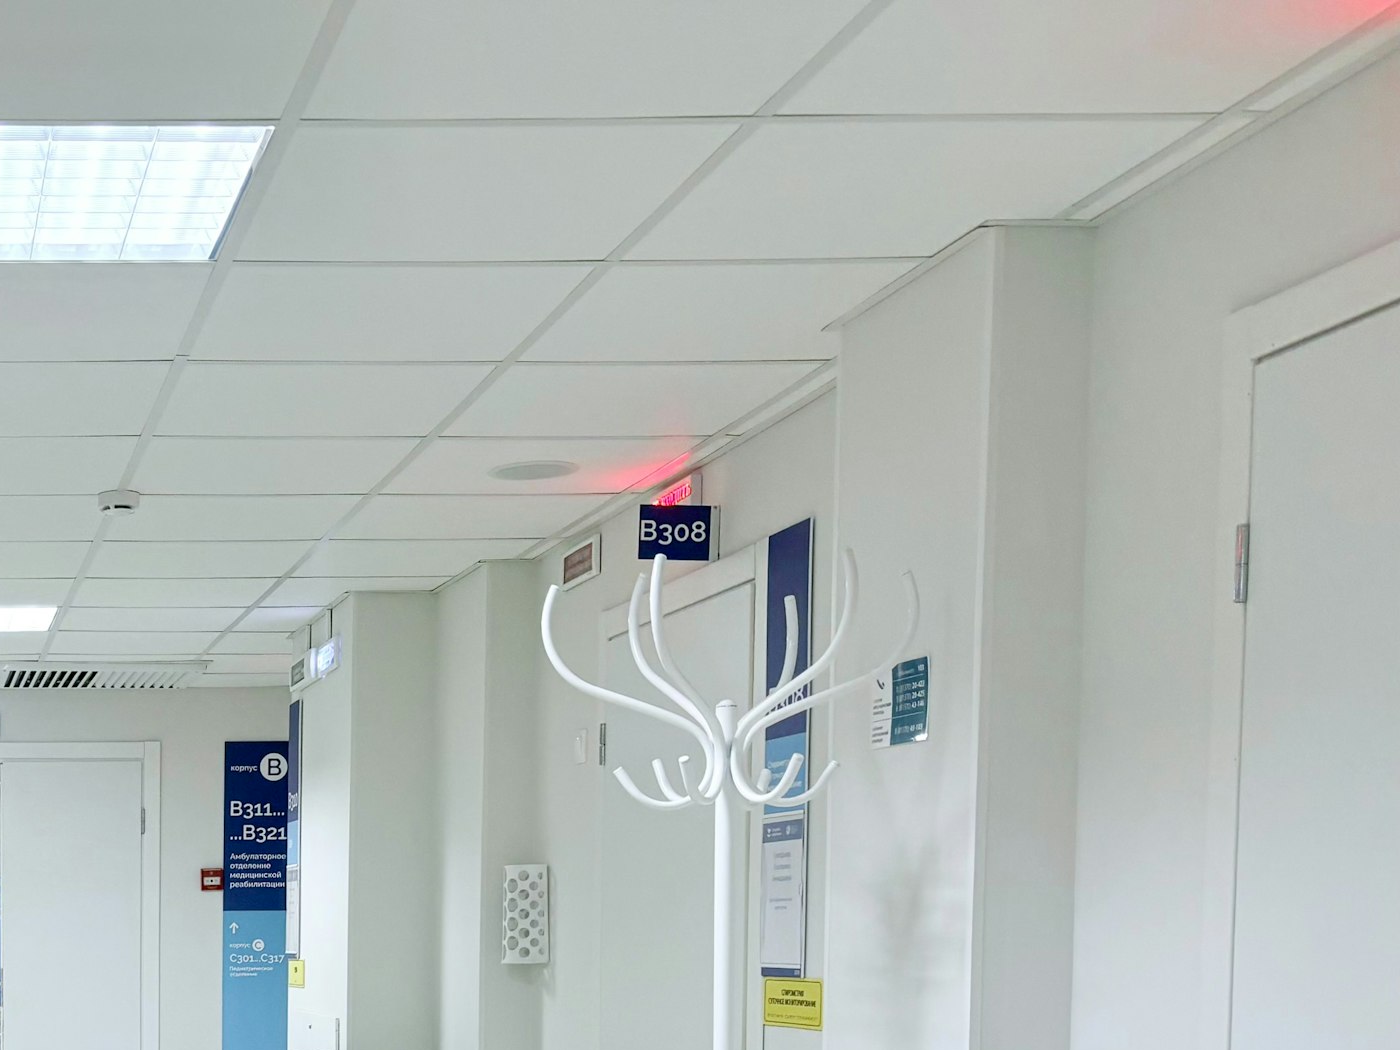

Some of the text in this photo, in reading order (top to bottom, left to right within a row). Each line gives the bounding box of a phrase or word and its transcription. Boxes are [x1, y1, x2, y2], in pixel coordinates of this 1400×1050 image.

[640, 520, 706, 545] B308
[230, 758, 281, 776] корпус B
